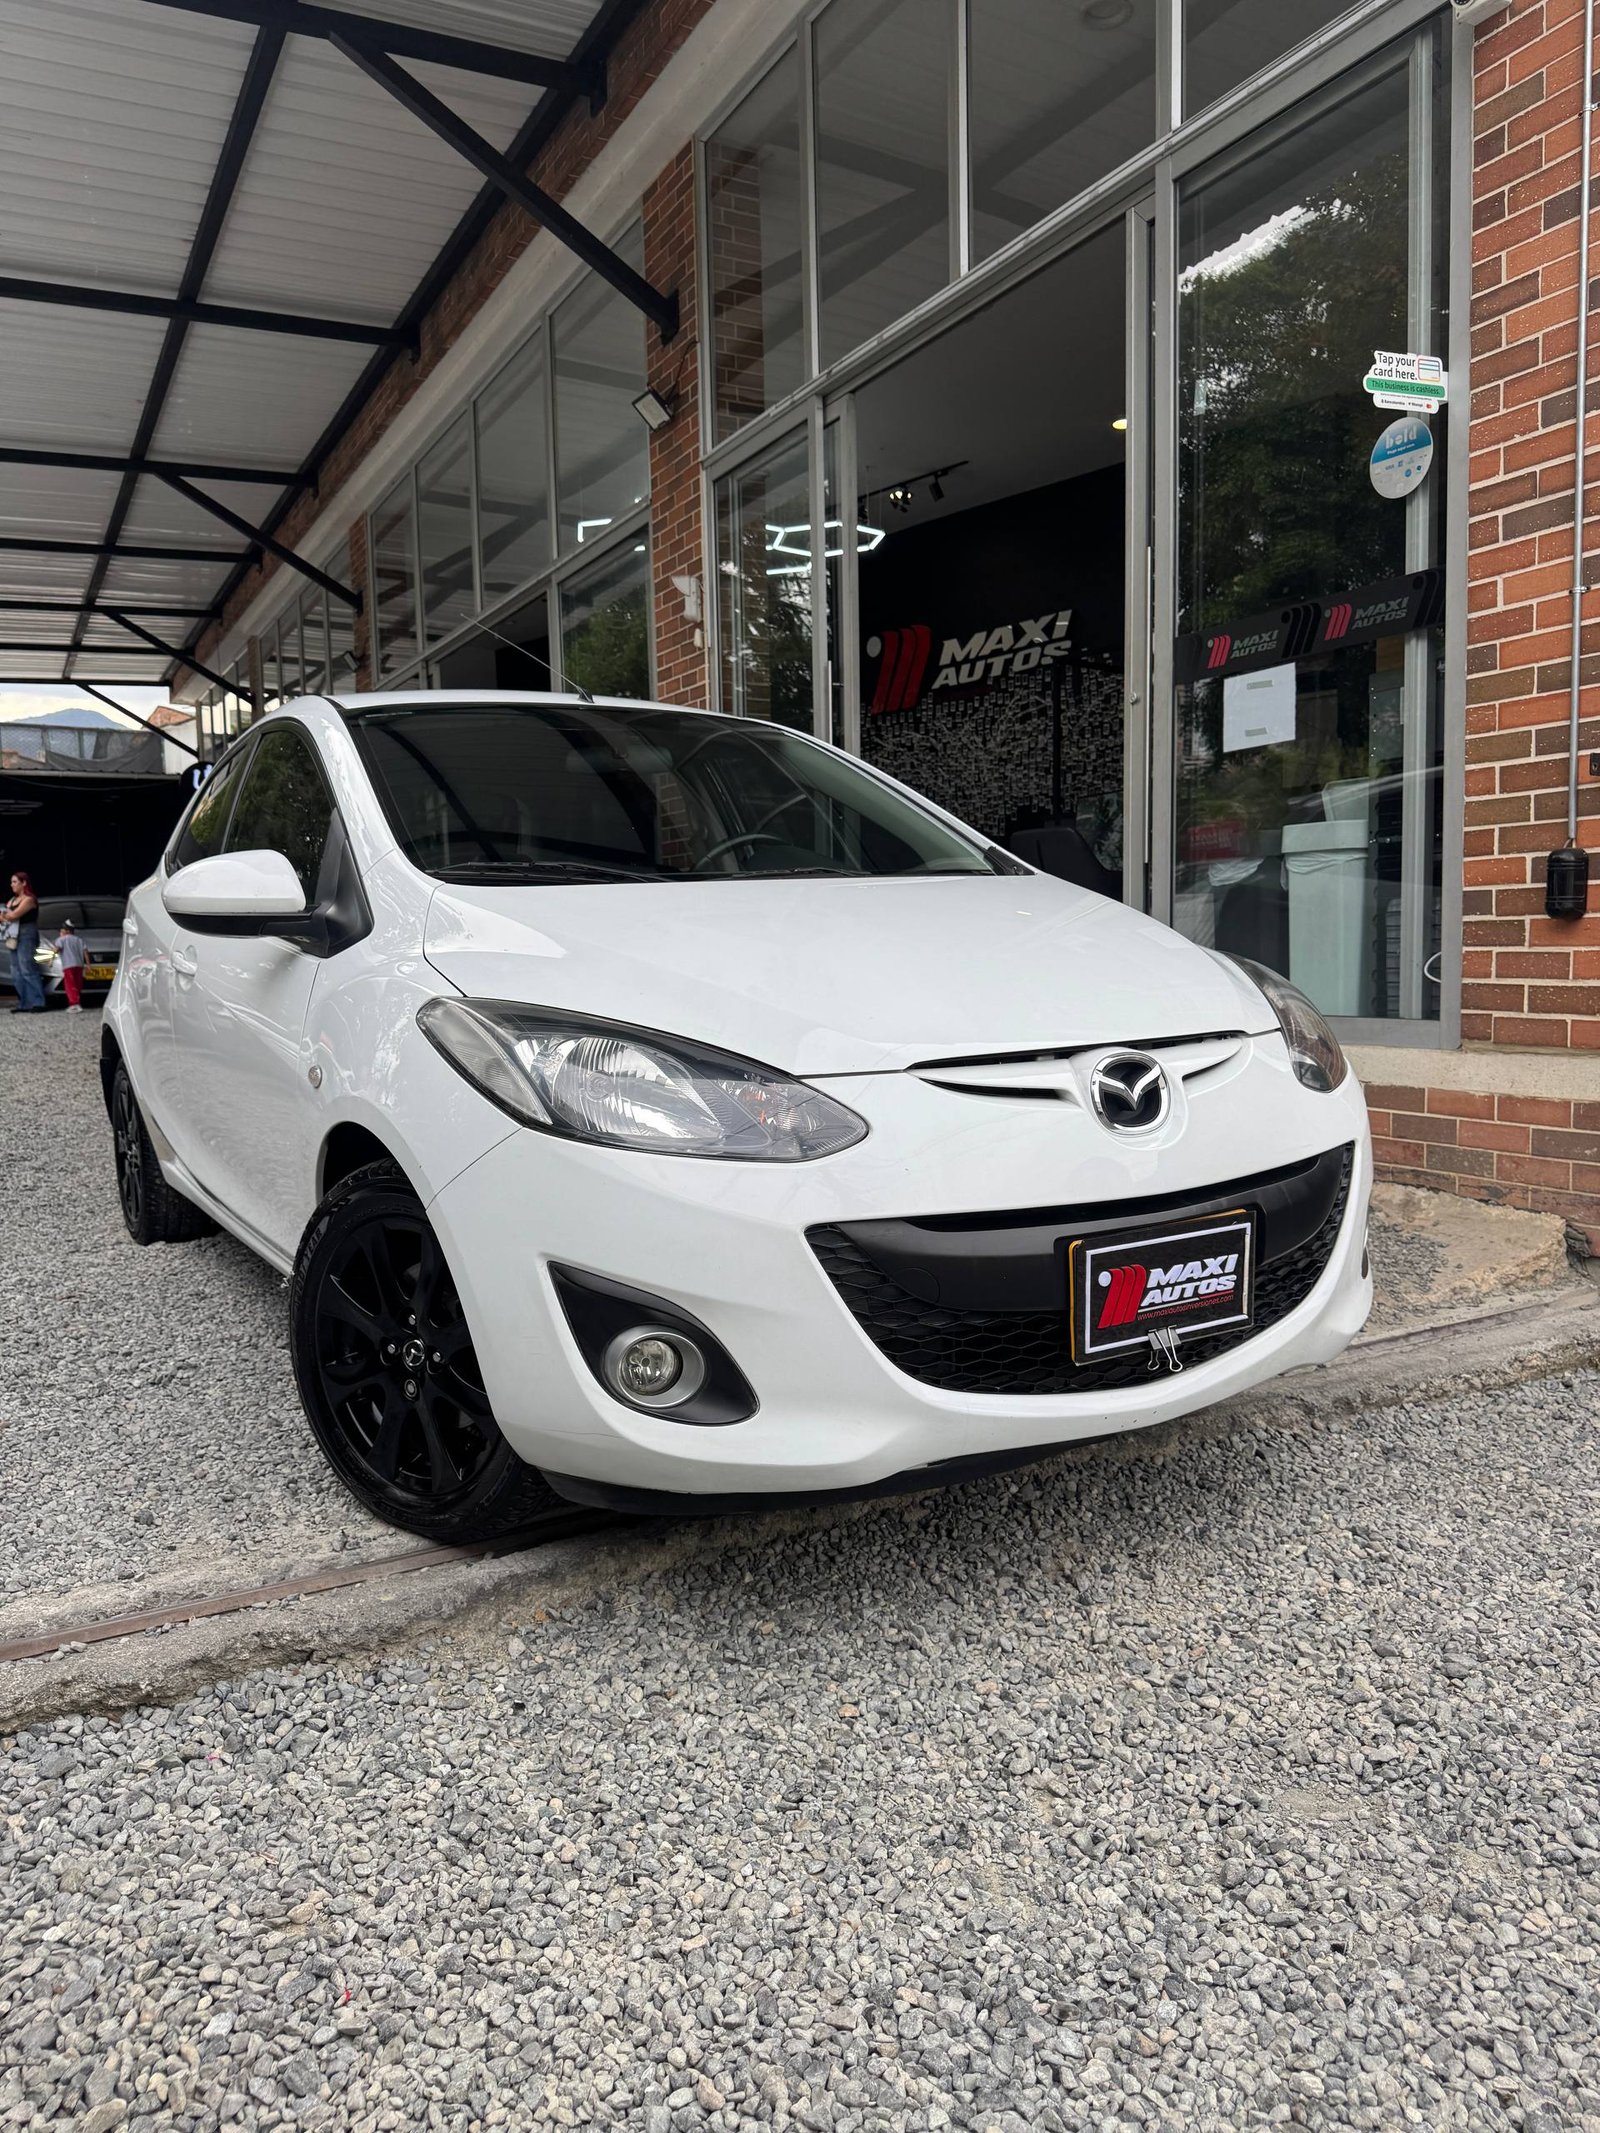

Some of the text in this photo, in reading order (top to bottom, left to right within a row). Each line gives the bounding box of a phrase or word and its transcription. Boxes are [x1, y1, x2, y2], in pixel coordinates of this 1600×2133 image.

[1377, 352, 1416, 367] Tap your
[1373, 367, 1418, 380] card here.
[1372, 380, 1384, 388] This
[1384, 381, 1410, 392] business
[1385, 424, 1417, 449] bold
[1351, 608, 1408, 630] AUTOS
[1354, 596, 1409, 620] MAXI
[938, 609, 1073, 667] MAXI
[1232, 629, 1279, 650] MAXI
[1229, 641, 1278, 660] AUTOS
[931, 639, 1072, 690] AUTOS
[1146, 1253, 1239, 1288] MAXI
[1140, 1274, 1237, 1307] AUTOS
